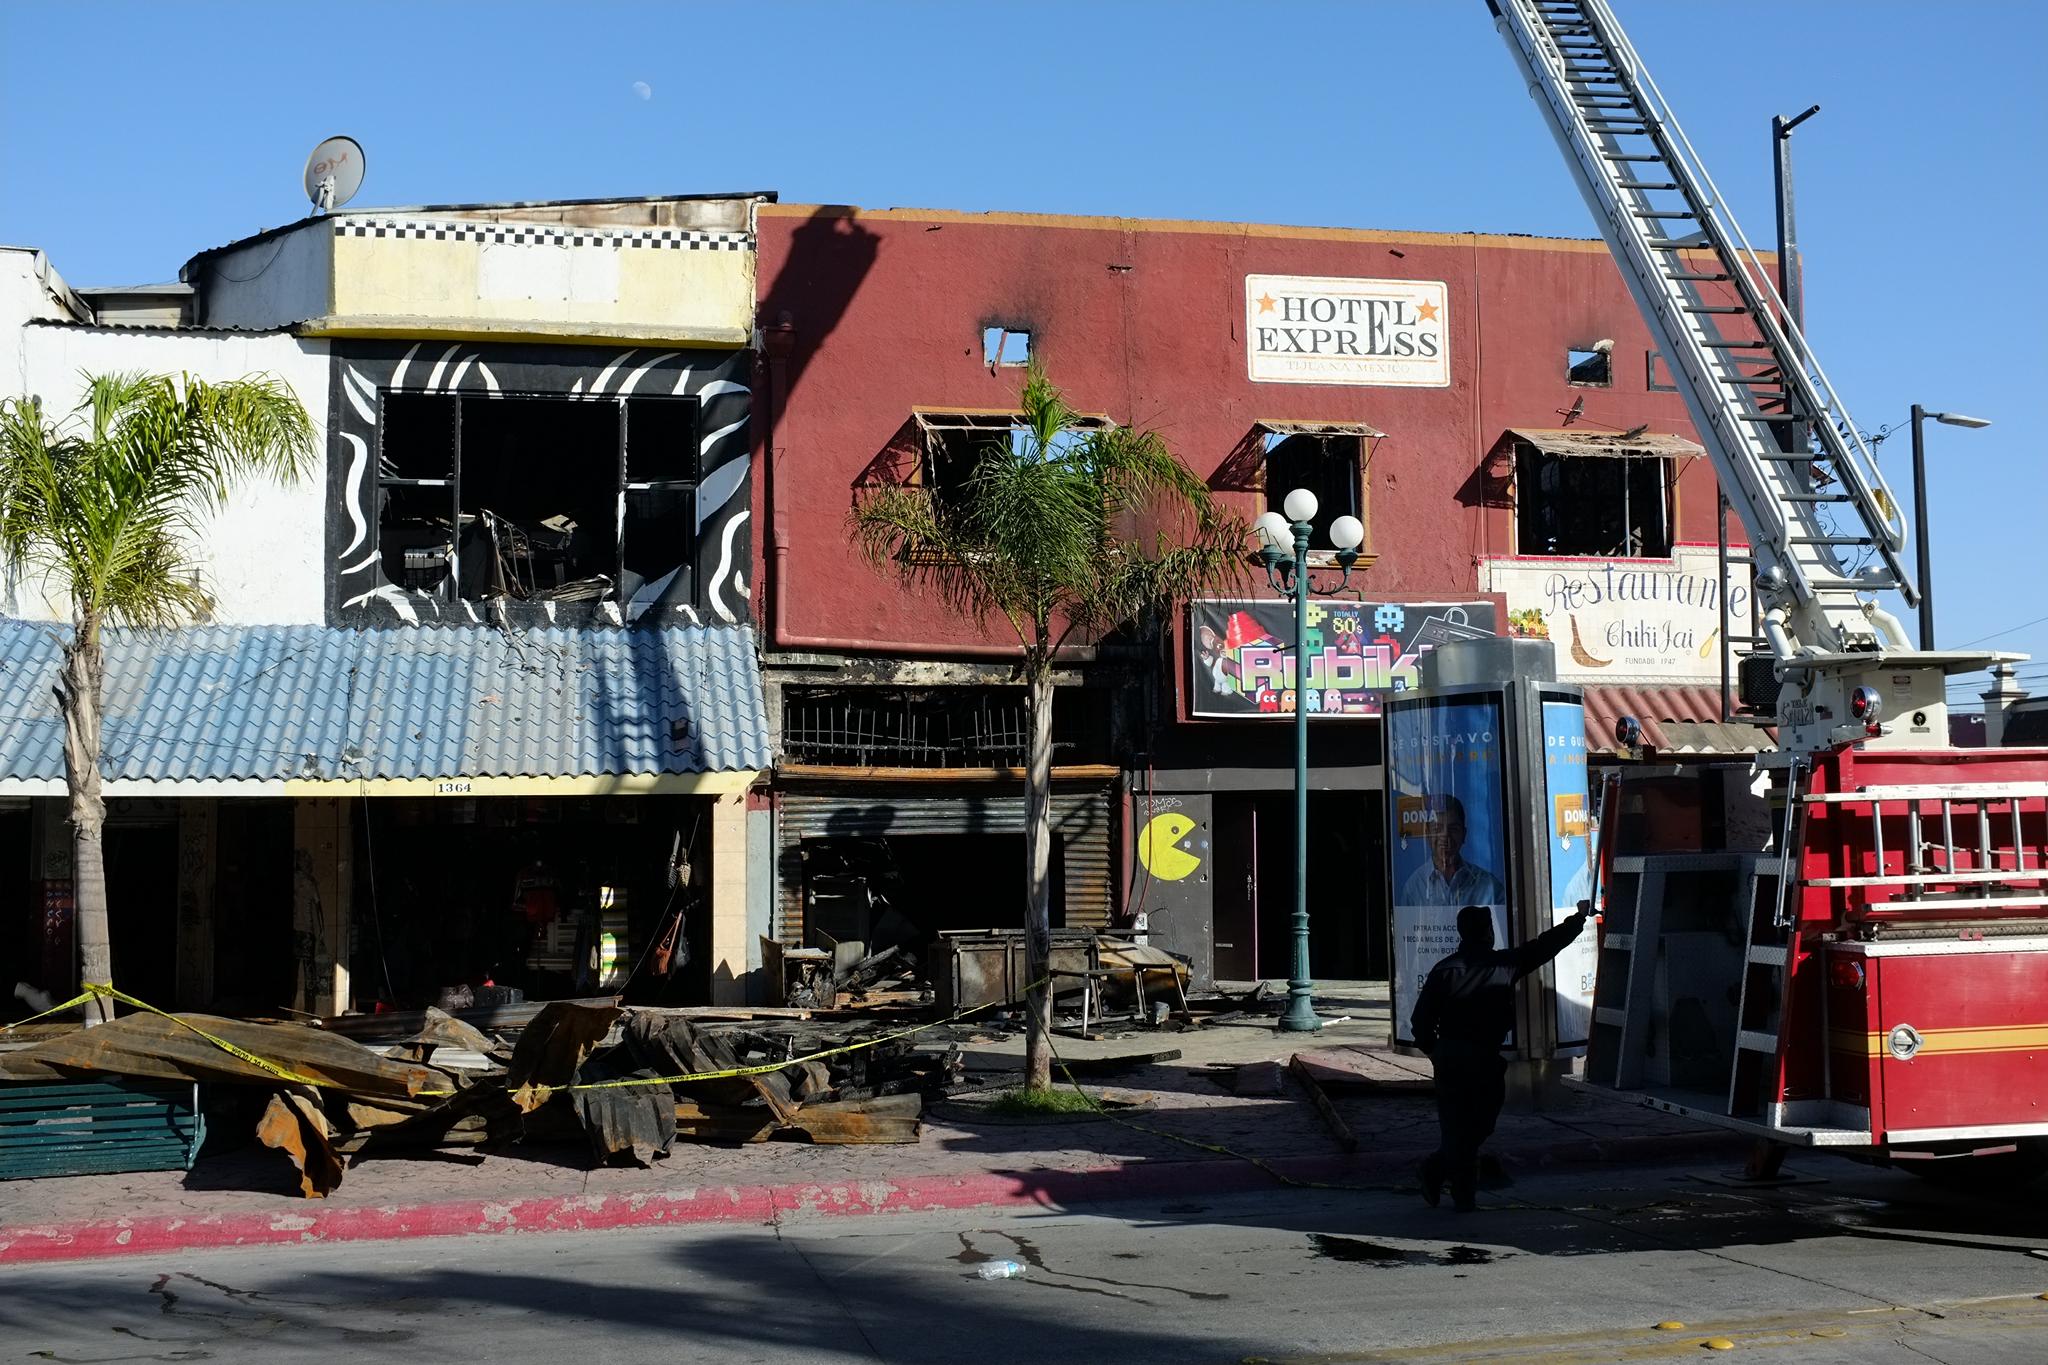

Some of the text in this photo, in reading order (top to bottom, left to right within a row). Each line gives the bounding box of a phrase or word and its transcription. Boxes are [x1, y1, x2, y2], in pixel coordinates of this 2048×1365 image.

[1280, 297, 1417, 334] HOTEL
[1256, 319, 1438, 358] EXPRESS
[1286, 360, 1352, 372] TIJUANA
[1545, 561, 1748, 618] Restaurane
[1660, 657, 1676, 665] 1947
[1410, 731, 1493, 748] GUSTAVO
[1548, 735, 1566, 748] DE
[438, 783, 472, 793] 1364
[1402, 809, 1438, 825] DONA
